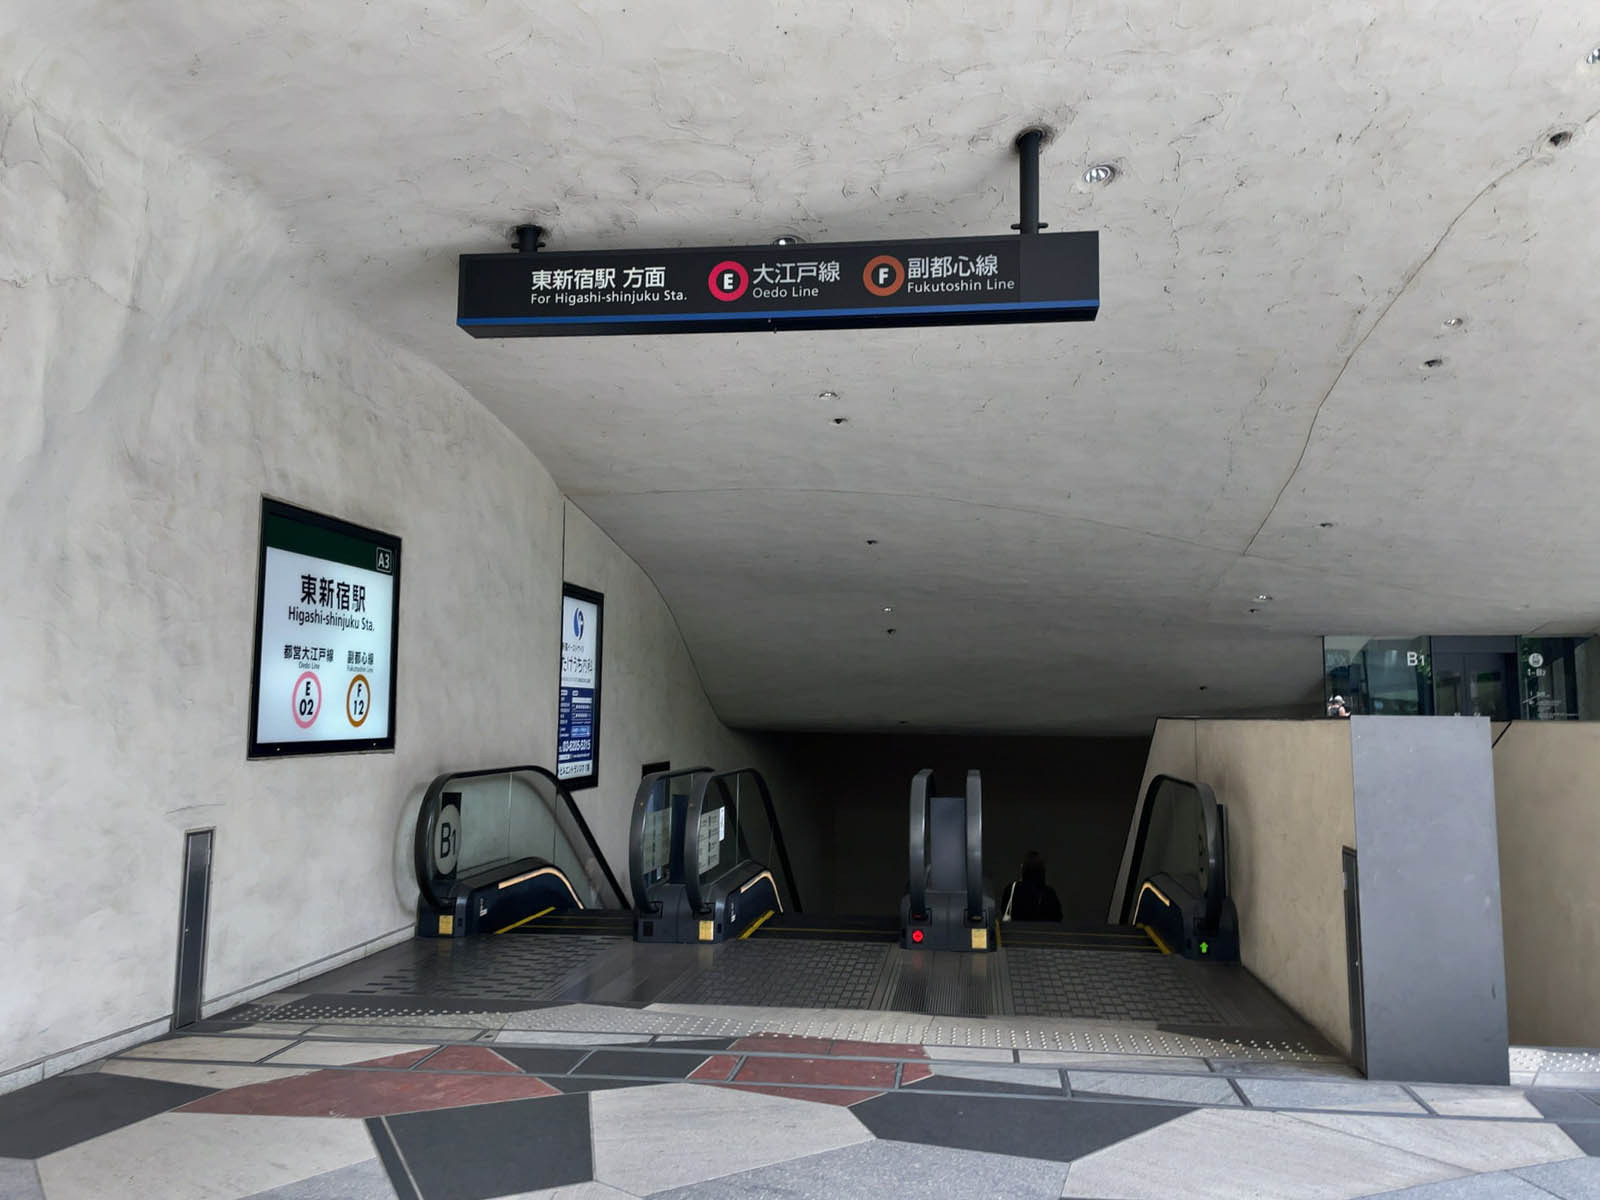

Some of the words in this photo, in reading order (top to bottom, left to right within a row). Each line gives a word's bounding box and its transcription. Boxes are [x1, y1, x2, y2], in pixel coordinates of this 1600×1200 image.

[752, 260, 840, 284] 大江戸線
[908, 254, 998, 279] 副都心線
[531, 268, 616, 291] 東新宿駅
[623, 266, 666, 288] 方面
[723, 273, 734, 290] E
[878, 268, 889, 285] F
[752, 286, 788, 298] Oedo
[792, 286, 819, 297] Line
[908, 280, 982, 293] Fukutoshin
[986, 278, 1015, 290] Line
[531, 293, 551, 304] For
[555, 290, 660, 305] Higashi-shinjuku
[664, 289, 688, 301] Sta.
[377, 552, 390, 569] A3
[300, 573, 366, 612] 東新宿駅
[288, 606, 360, 631] Higashi-shinjuku
[361, 617, 375, 631] Sta.
[283, 644, 334, 663] 都営大江戸線
[347, 650, 374, 666] 副都心線
[1407, 651, 1425, 666] B1
[305, 681, 311, 696] E
[357, 683, 362, 697] F
[299, 699, 314, 716] 02
[353, 700, 364, 715] 12
[440, 822, 456, 859] B1
